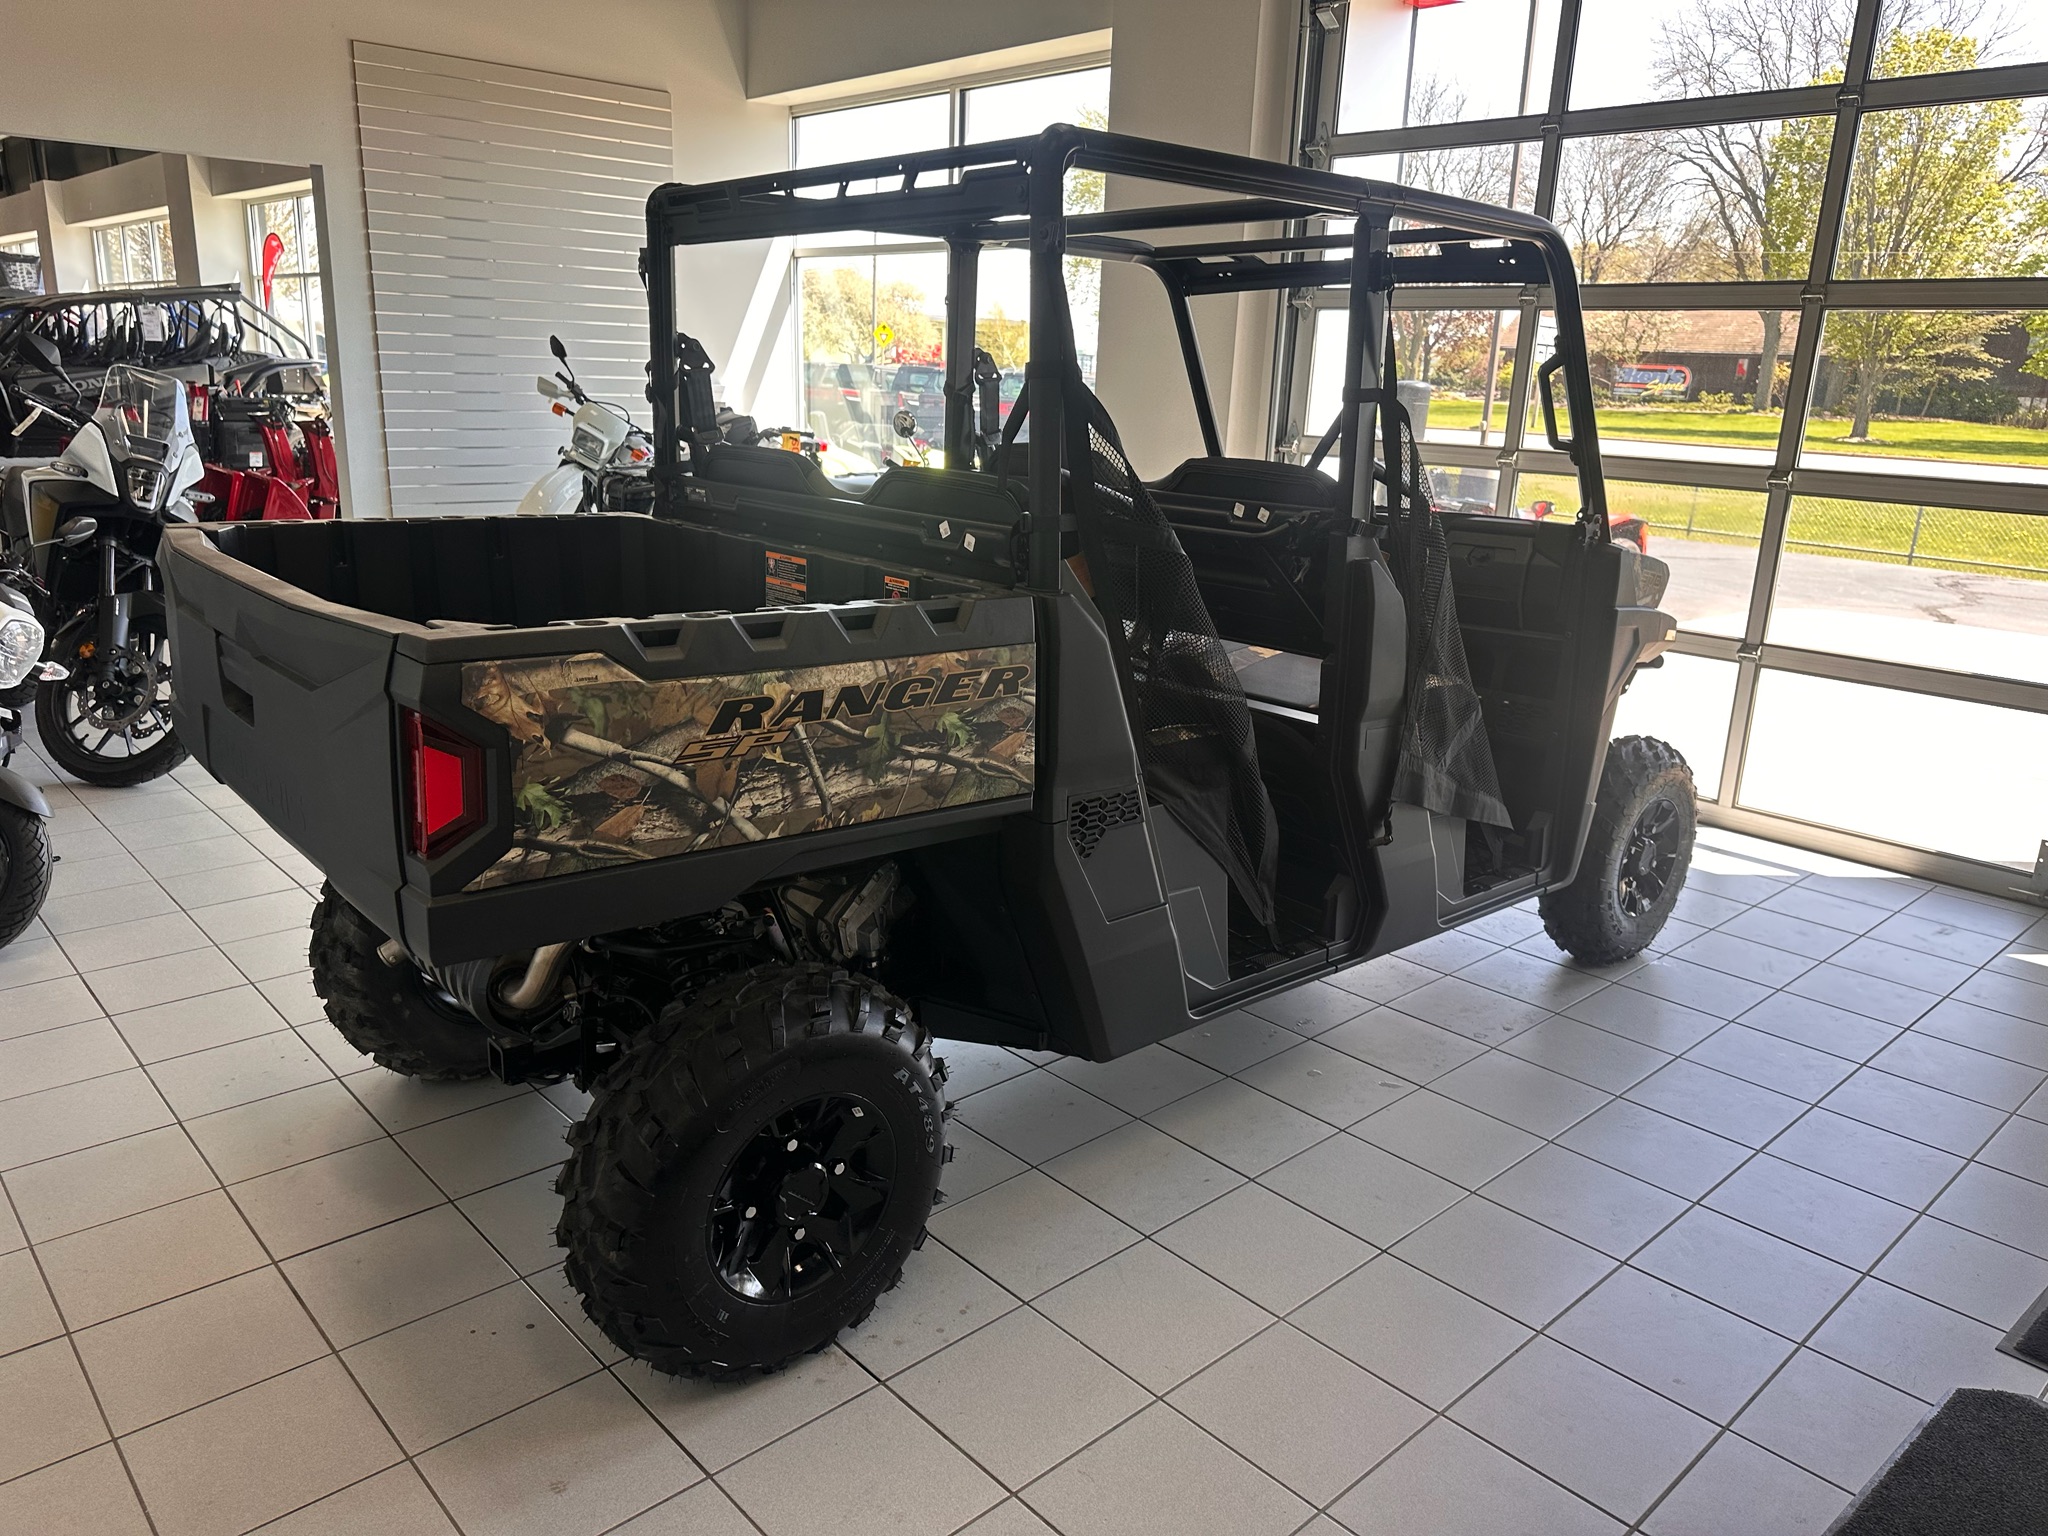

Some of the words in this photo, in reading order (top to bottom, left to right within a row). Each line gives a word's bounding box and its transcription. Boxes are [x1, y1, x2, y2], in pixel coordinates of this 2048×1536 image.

[1641, 378, 1686, 397] Sports
[705, 664, 1030, 736] RANGER
[672, 729, 793, 766] SP
[893, 1066, 935, 1154] AT489
